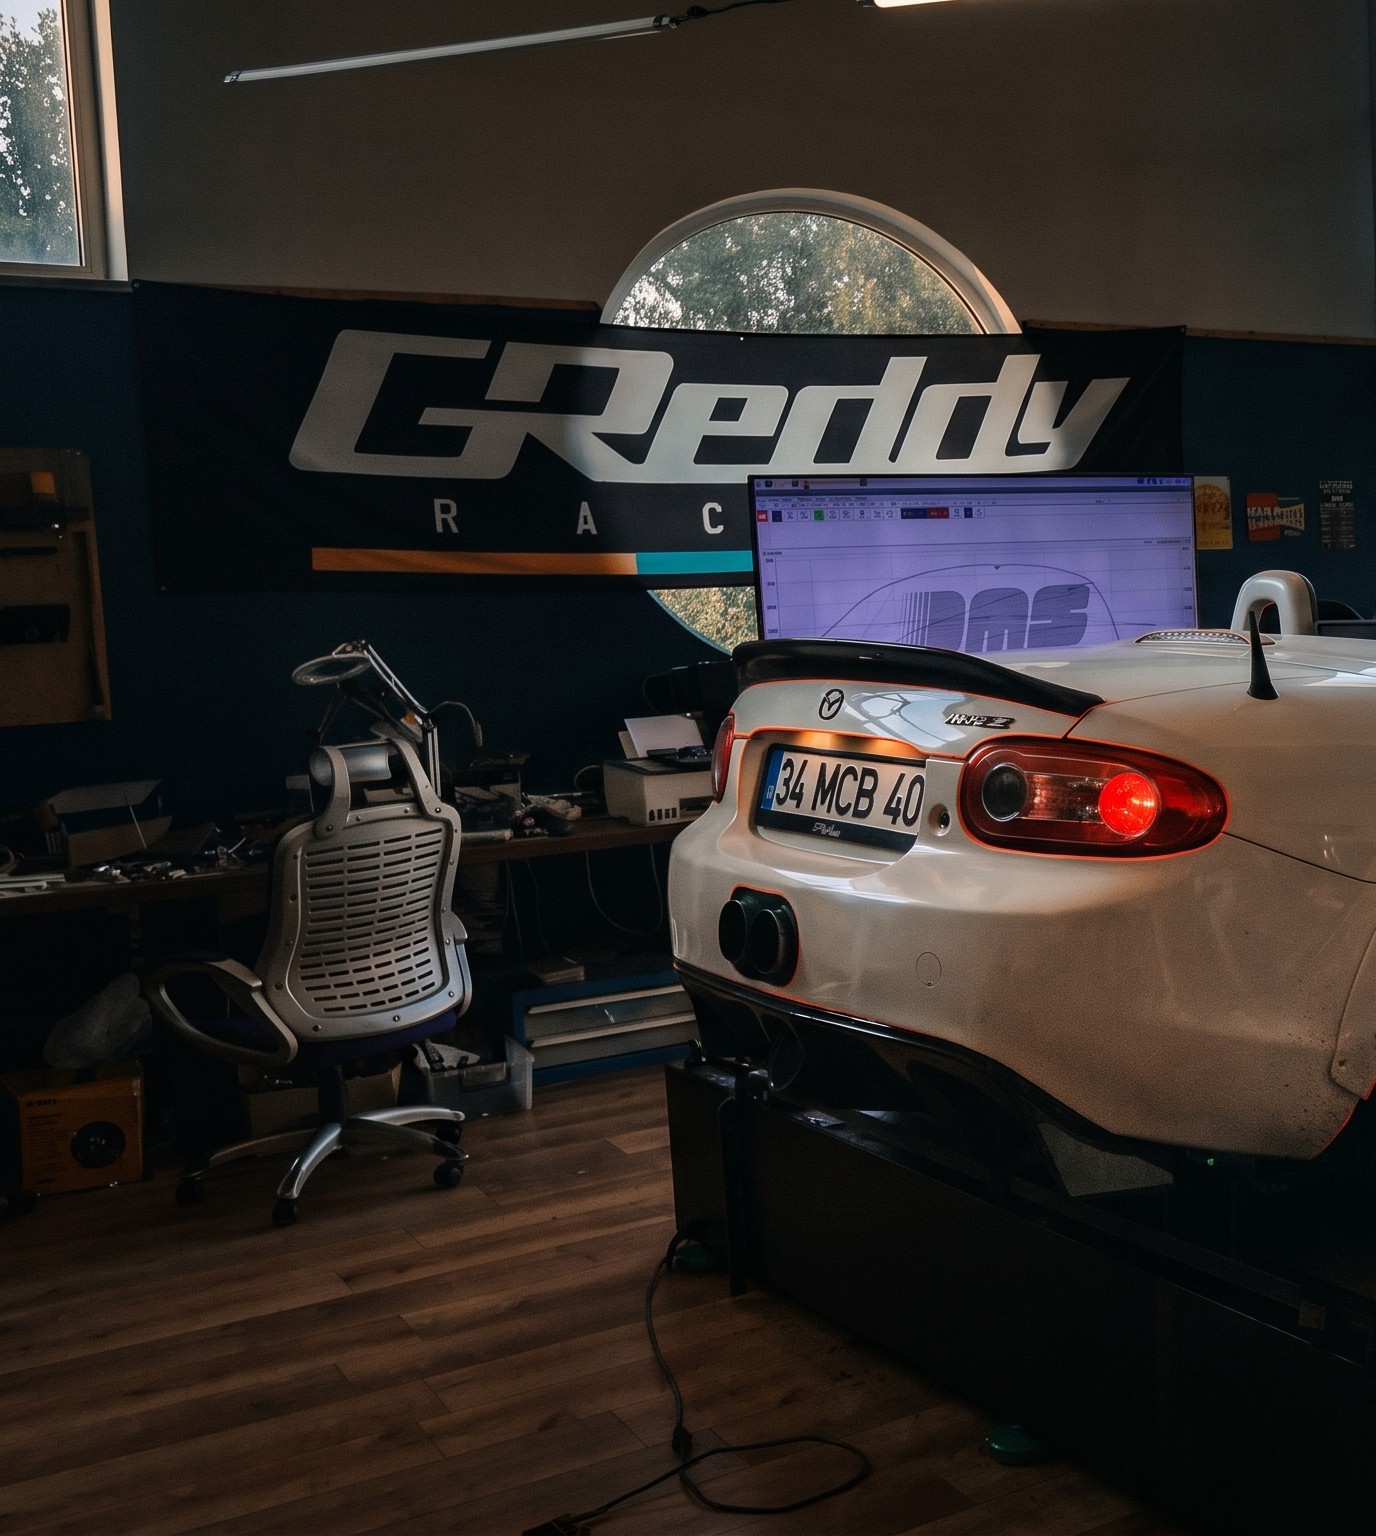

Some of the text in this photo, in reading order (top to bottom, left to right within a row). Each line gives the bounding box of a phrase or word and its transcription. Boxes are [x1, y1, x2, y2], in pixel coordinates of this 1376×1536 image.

[288, 329, 1131, 482] GReddy
[433, 498, 725, 536] RAC
[776, 757, 925, 827] 34 MCB 40
